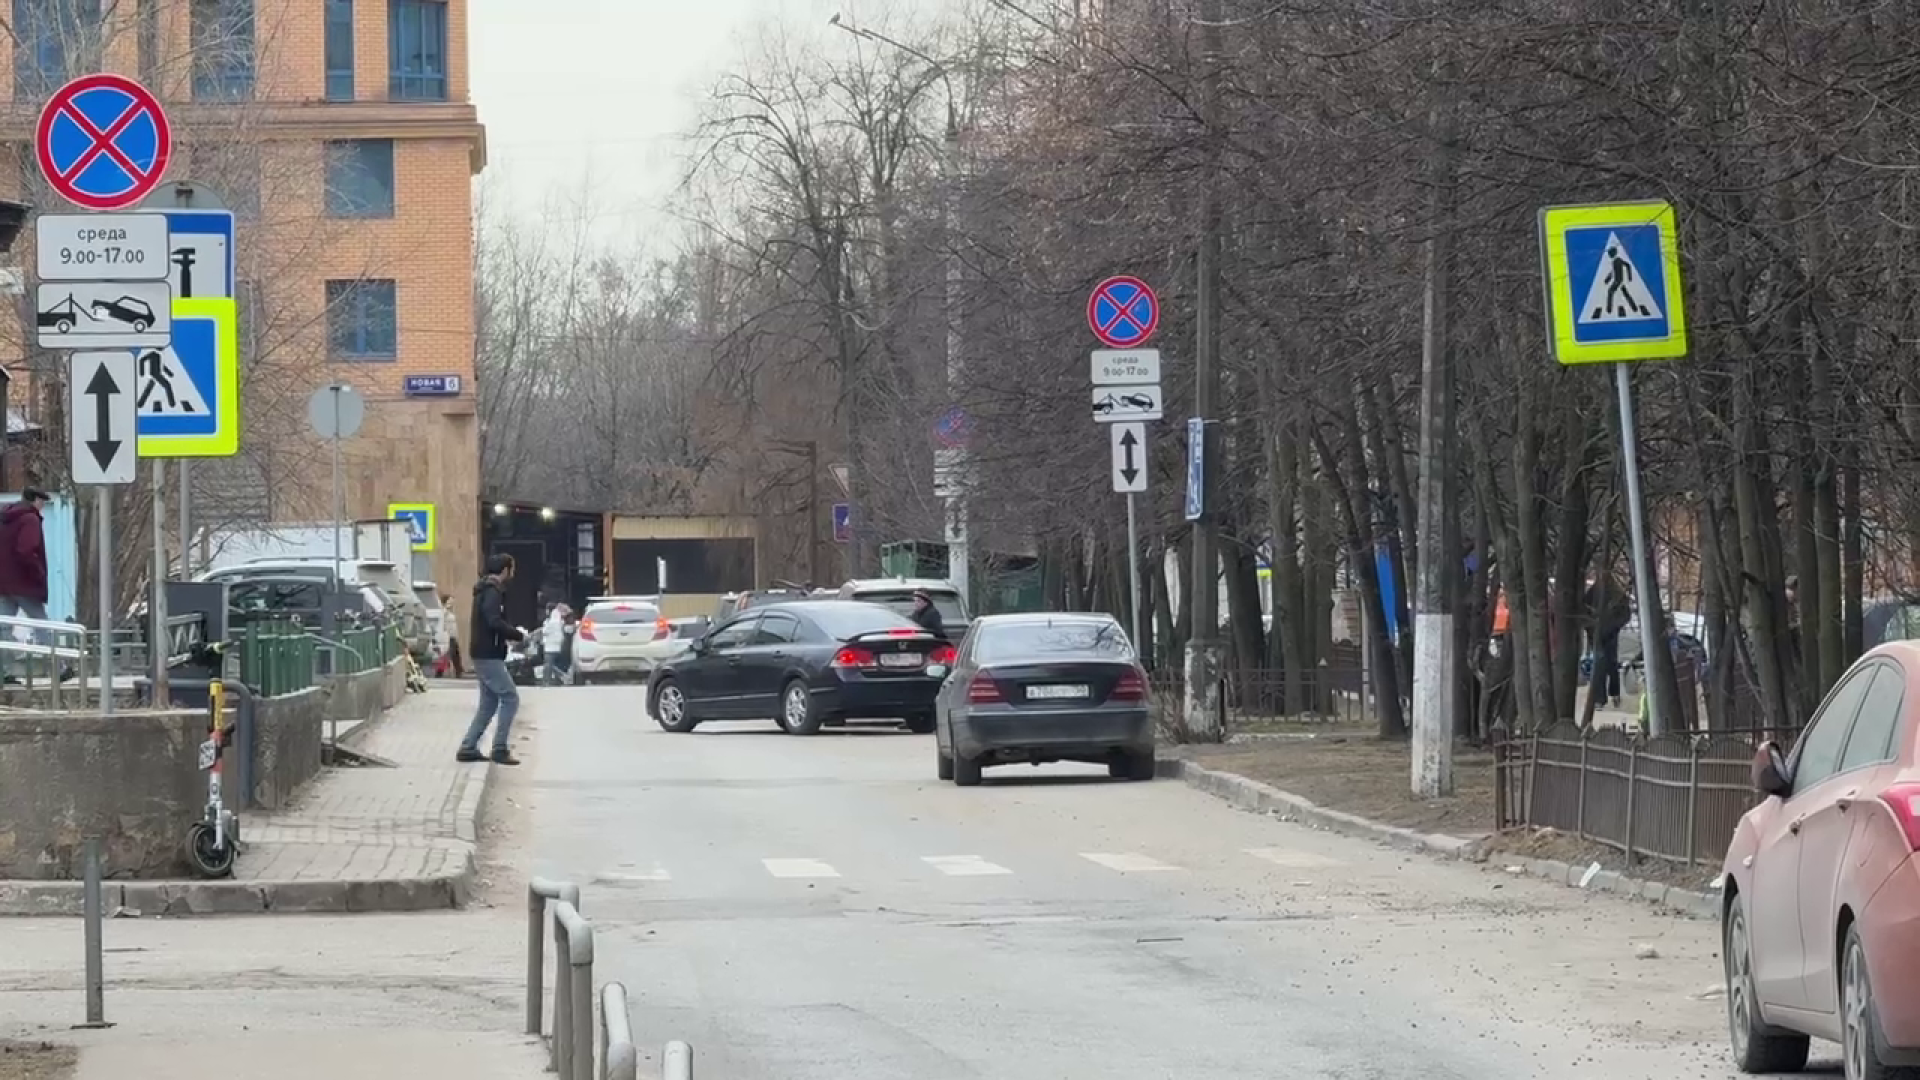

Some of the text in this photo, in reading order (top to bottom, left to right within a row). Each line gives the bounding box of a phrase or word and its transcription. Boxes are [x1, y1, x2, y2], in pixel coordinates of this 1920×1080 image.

[77, 228, 127, 243] среда
[60, 247, 145, 265] 9.00-17.00
[1112, 356, 1139, 365] среда
